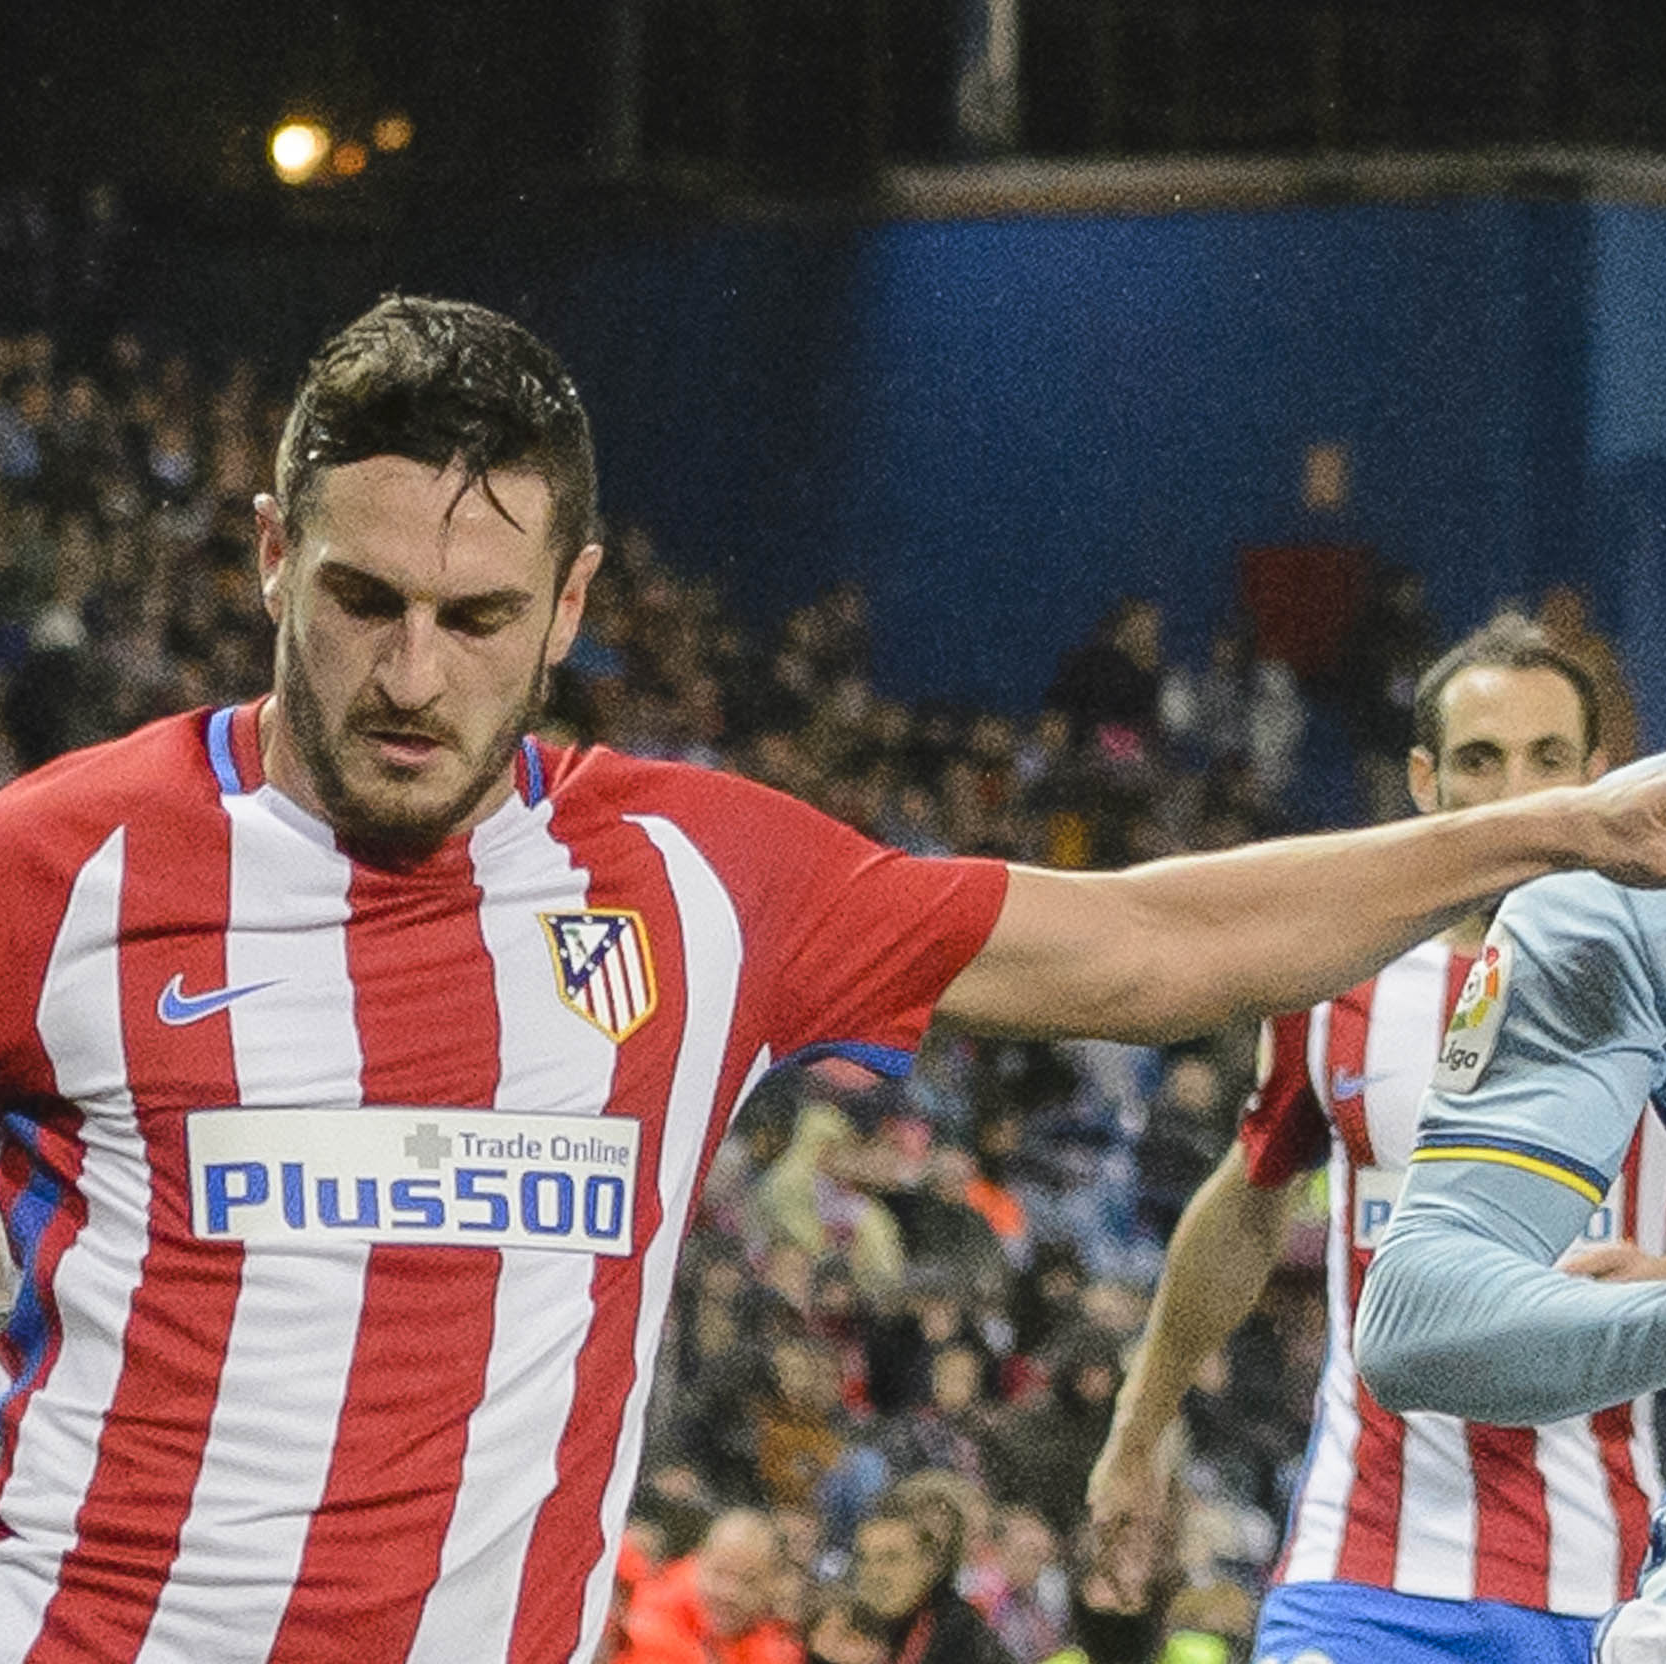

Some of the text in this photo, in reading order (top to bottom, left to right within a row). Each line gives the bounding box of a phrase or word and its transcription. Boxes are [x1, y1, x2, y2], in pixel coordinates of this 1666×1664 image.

[458, 1132, 630, 1168] Trade Online
[204, 1161, 625, 1240] Plus500
